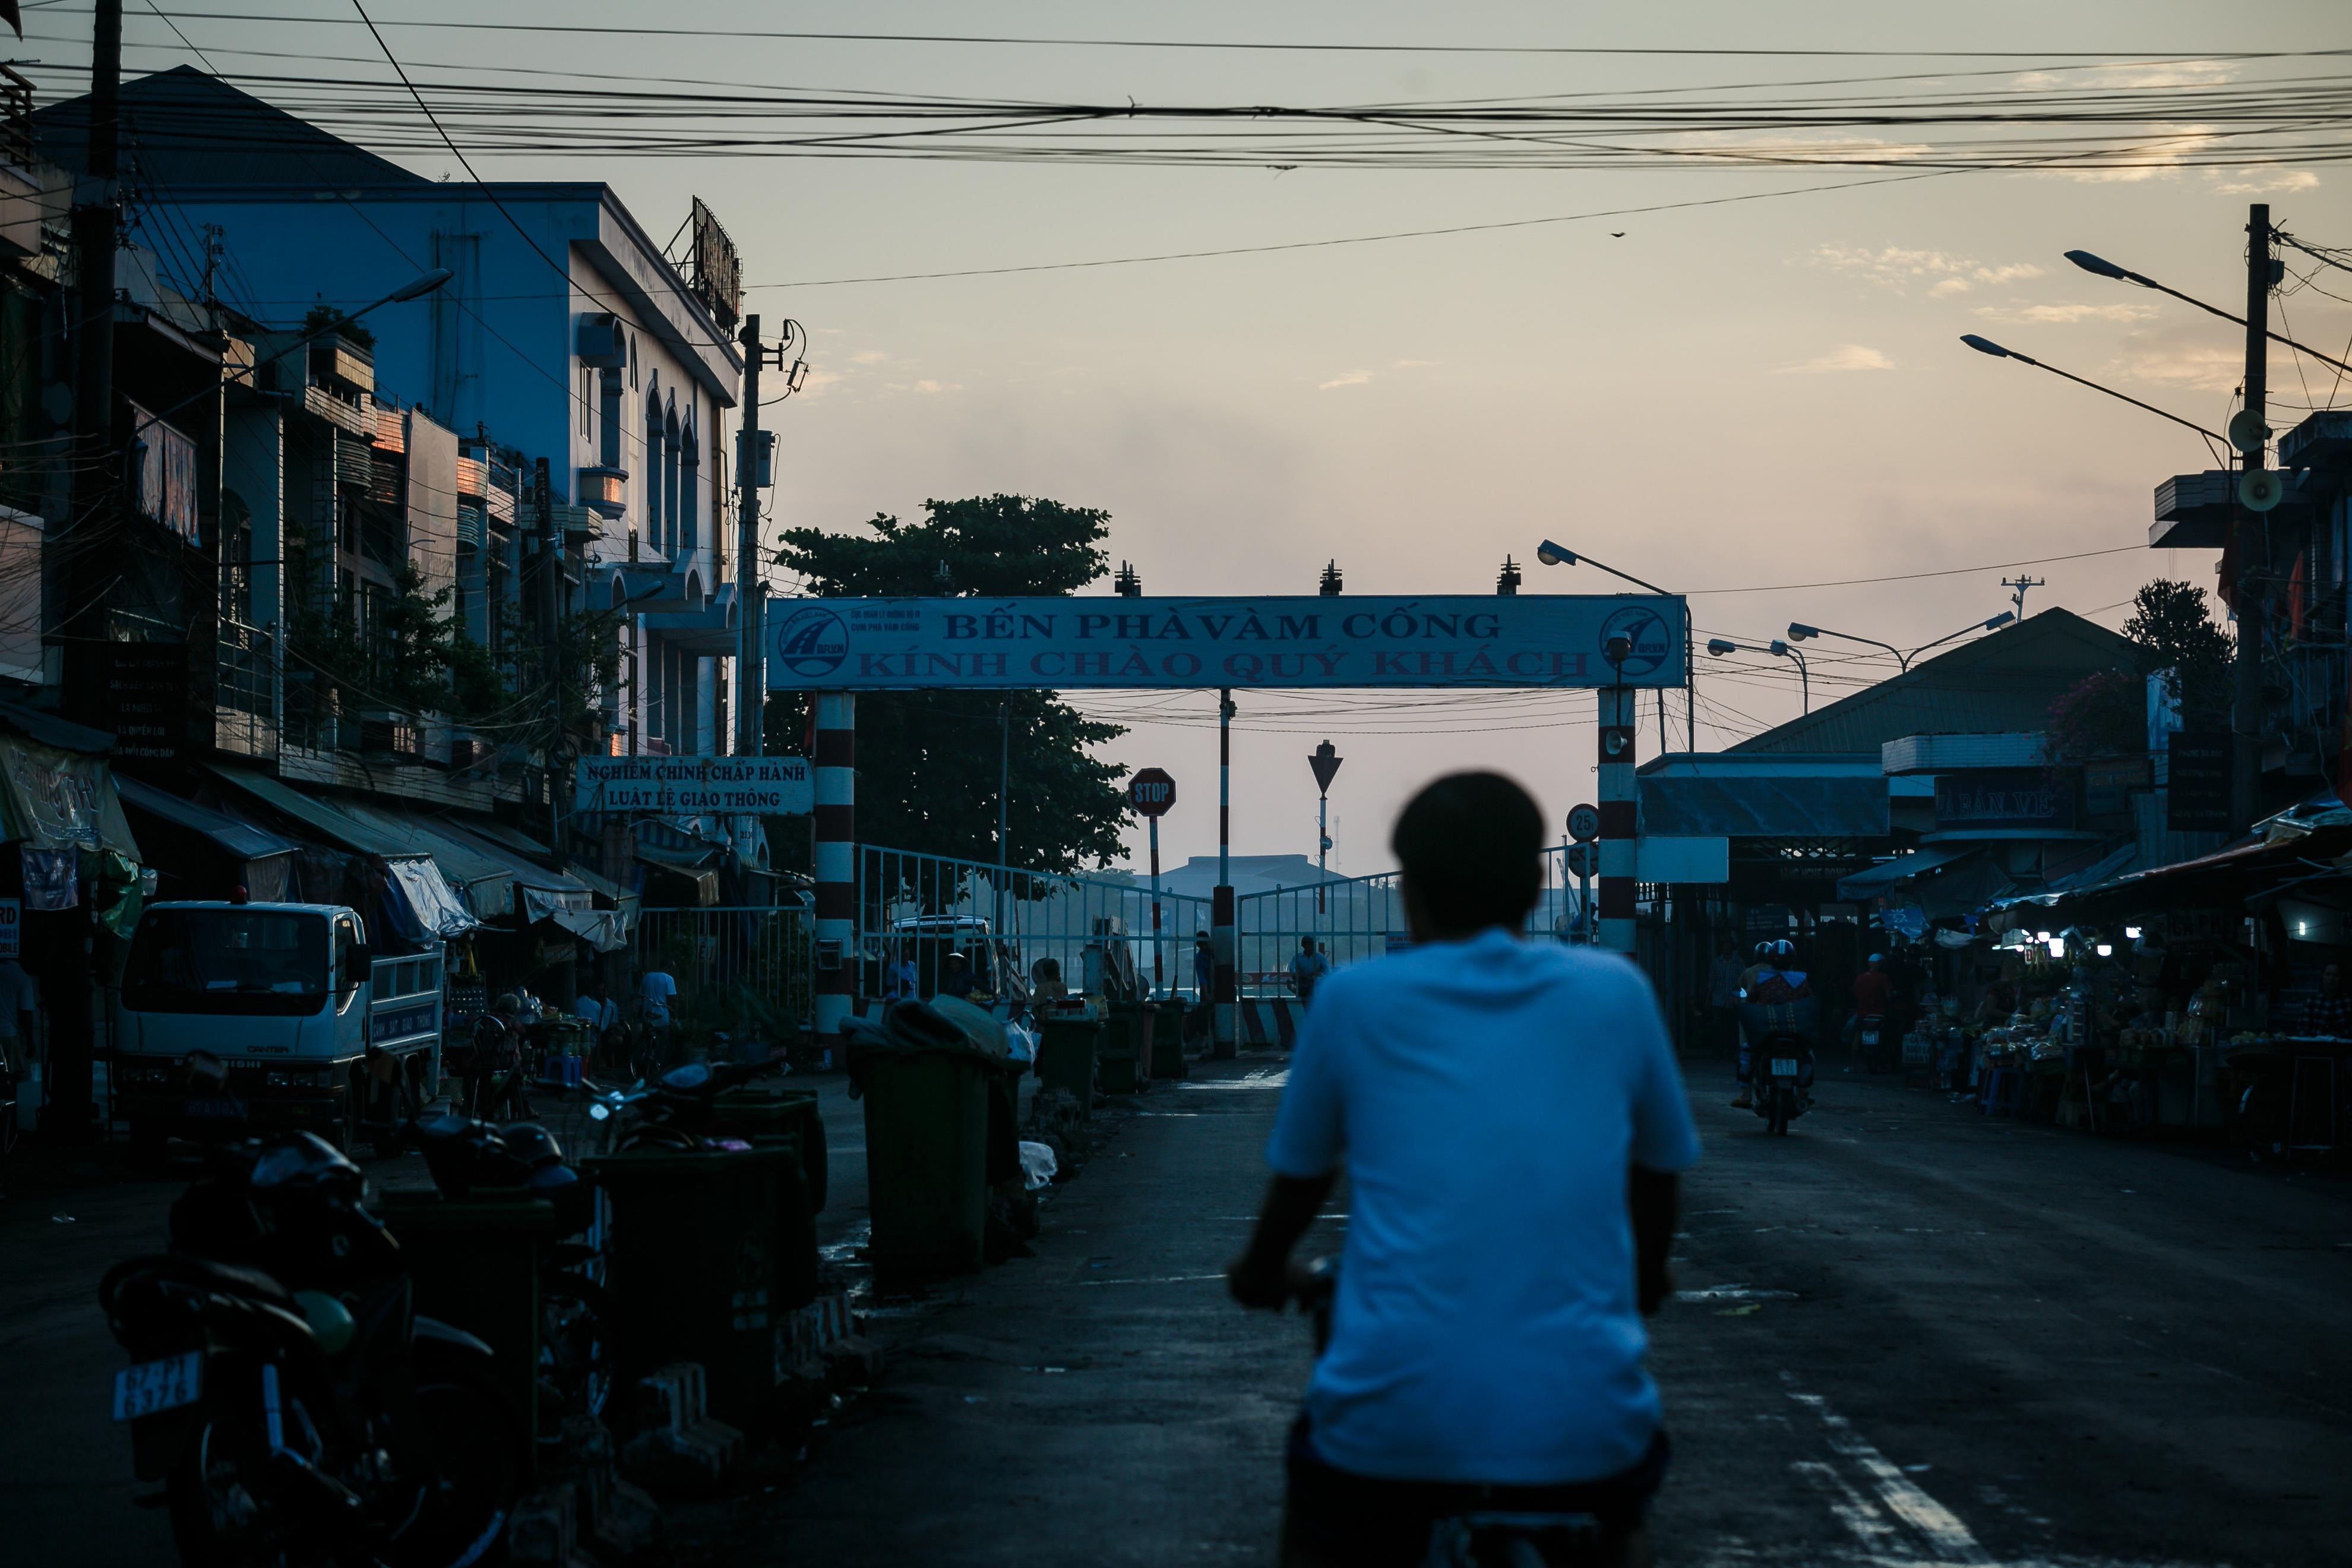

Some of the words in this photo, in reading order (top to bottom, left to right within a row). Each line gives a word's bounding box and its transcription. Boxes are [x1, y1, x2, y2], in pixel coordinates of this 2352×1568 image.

[943, 602, 1057, 640] BẾN
[1342, 602, 1503, 640] CỐNG
[855, 645, 1010, 678] KÍNH
[1029, 644, 1203, 678] CHÀO
[1222, 644, 1349, 683] QUÝ
[1370, 643, 1591, 677] KHÁCH
[587, 760, 652, 780] NGHIÊM
[656, 759, 706, 781] CHỈNH
[711, 759, 755, 781] CHẤP
[758, 760, 806, 782] HÀNH
[609, 788, 652, 809] LUẬT
[656, 788, 676, 810] LỆ
[680, 791, 720, 807] GIAO
[724, 788, 780, 807] THÔNG
[1135, 782, 1169, 803] STOP
[246, 1045, 289, 1054] CANTER
